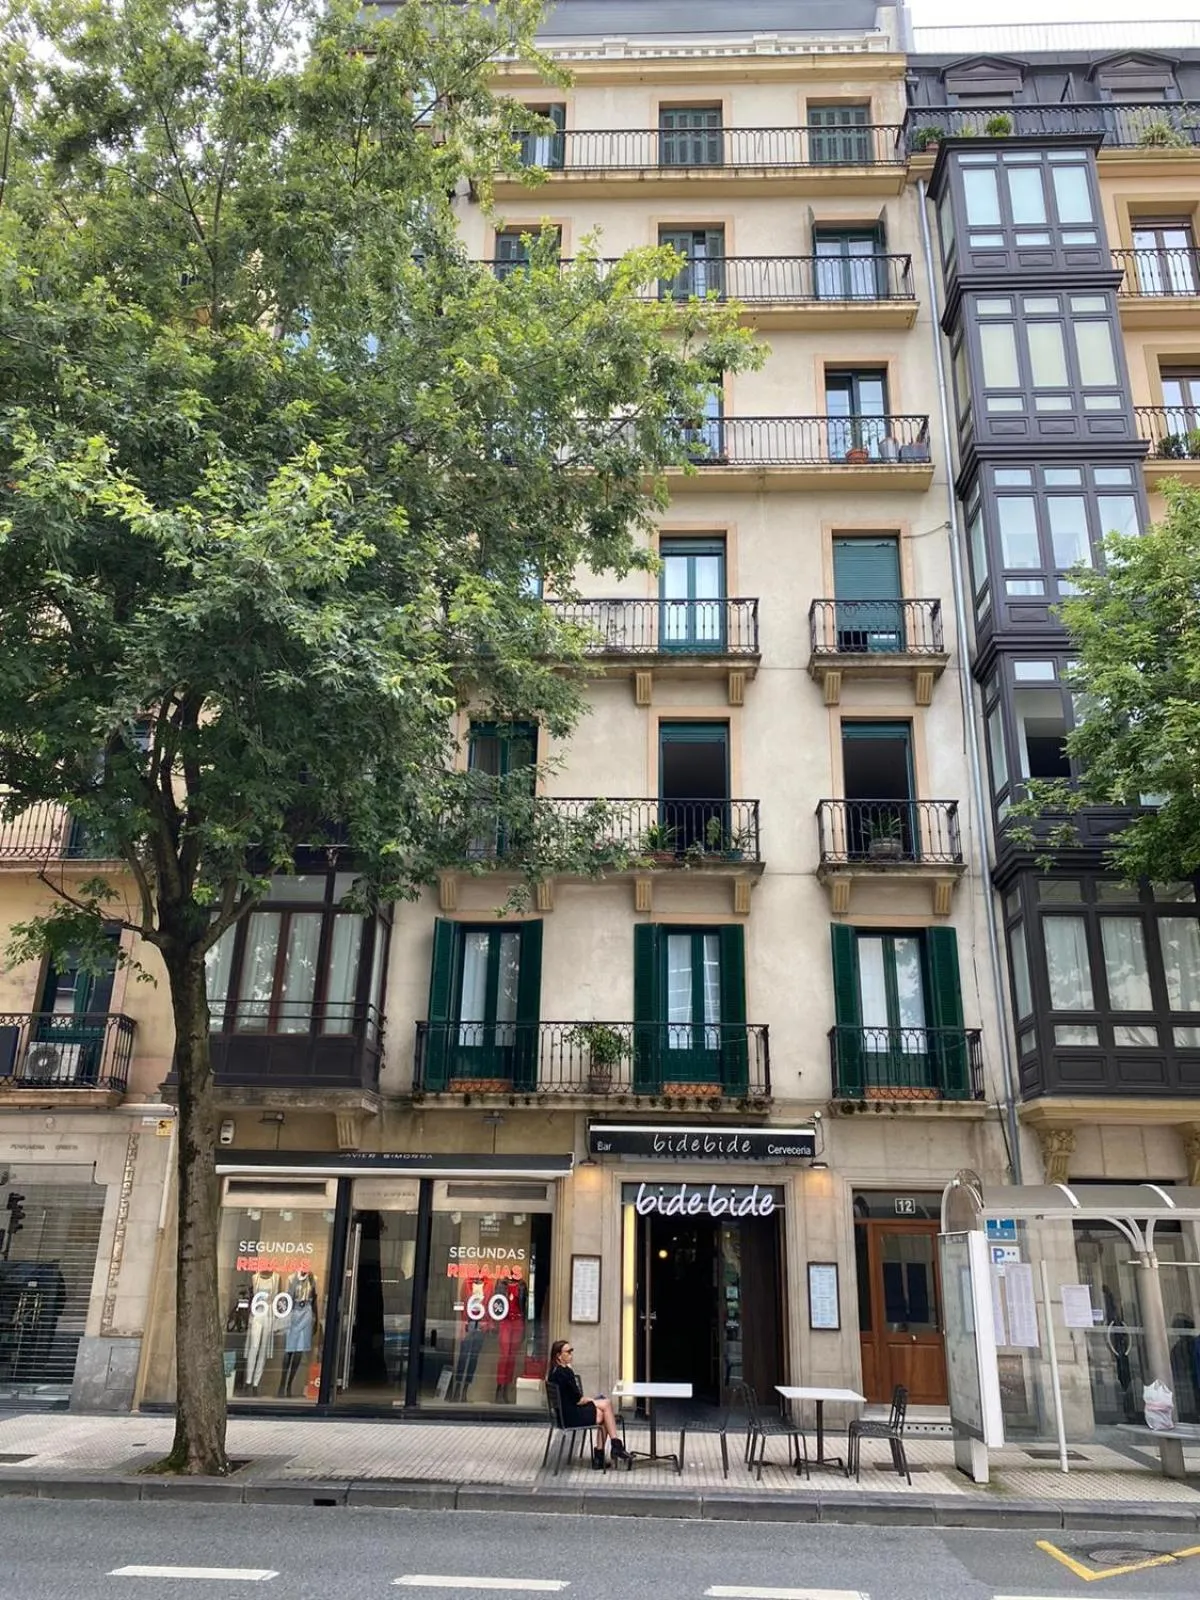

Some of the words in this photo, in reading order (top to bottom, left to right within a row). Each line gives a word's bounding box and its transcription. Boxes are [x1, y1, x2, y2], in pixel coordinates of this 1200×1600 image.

[597, 1140, 612, 1151] Bar
[898, 1200, 912, 1213] 12
[239, 1240, 314, 1254] SEGUNDAS
[449, 1246, 526, 1260] SEGUNDAS
[236, 1255, 311, 1272] REBAJAS
[446, 1263, 523, 1281] REBAJAS
